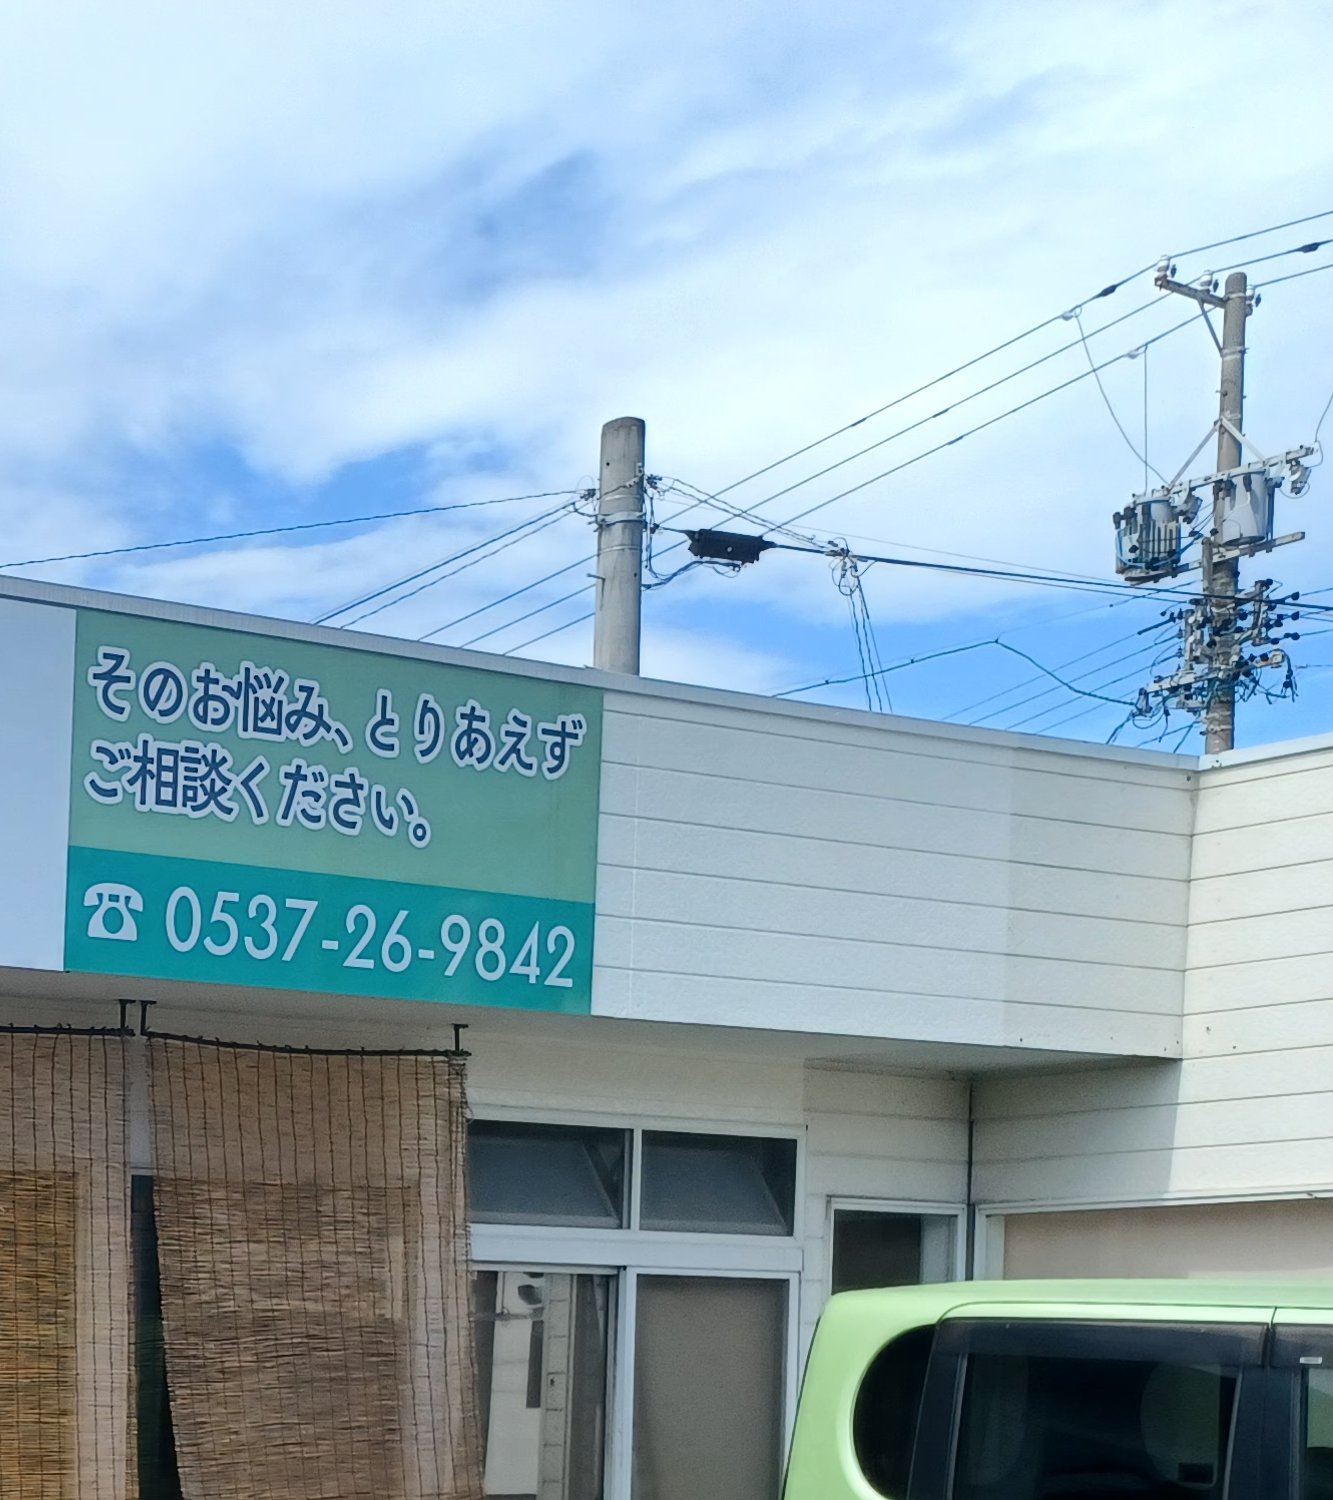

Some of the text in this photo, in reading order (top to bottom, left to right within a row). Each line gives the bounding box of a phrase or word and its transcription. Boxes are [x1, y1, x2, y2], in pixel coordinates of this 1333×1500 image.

[91, 652, 585, 774] そのお悩み、とりあえず
[88, 739, 429, 842] ご相談ください。
[165, 886, 576, 988] 0537-26-9842
